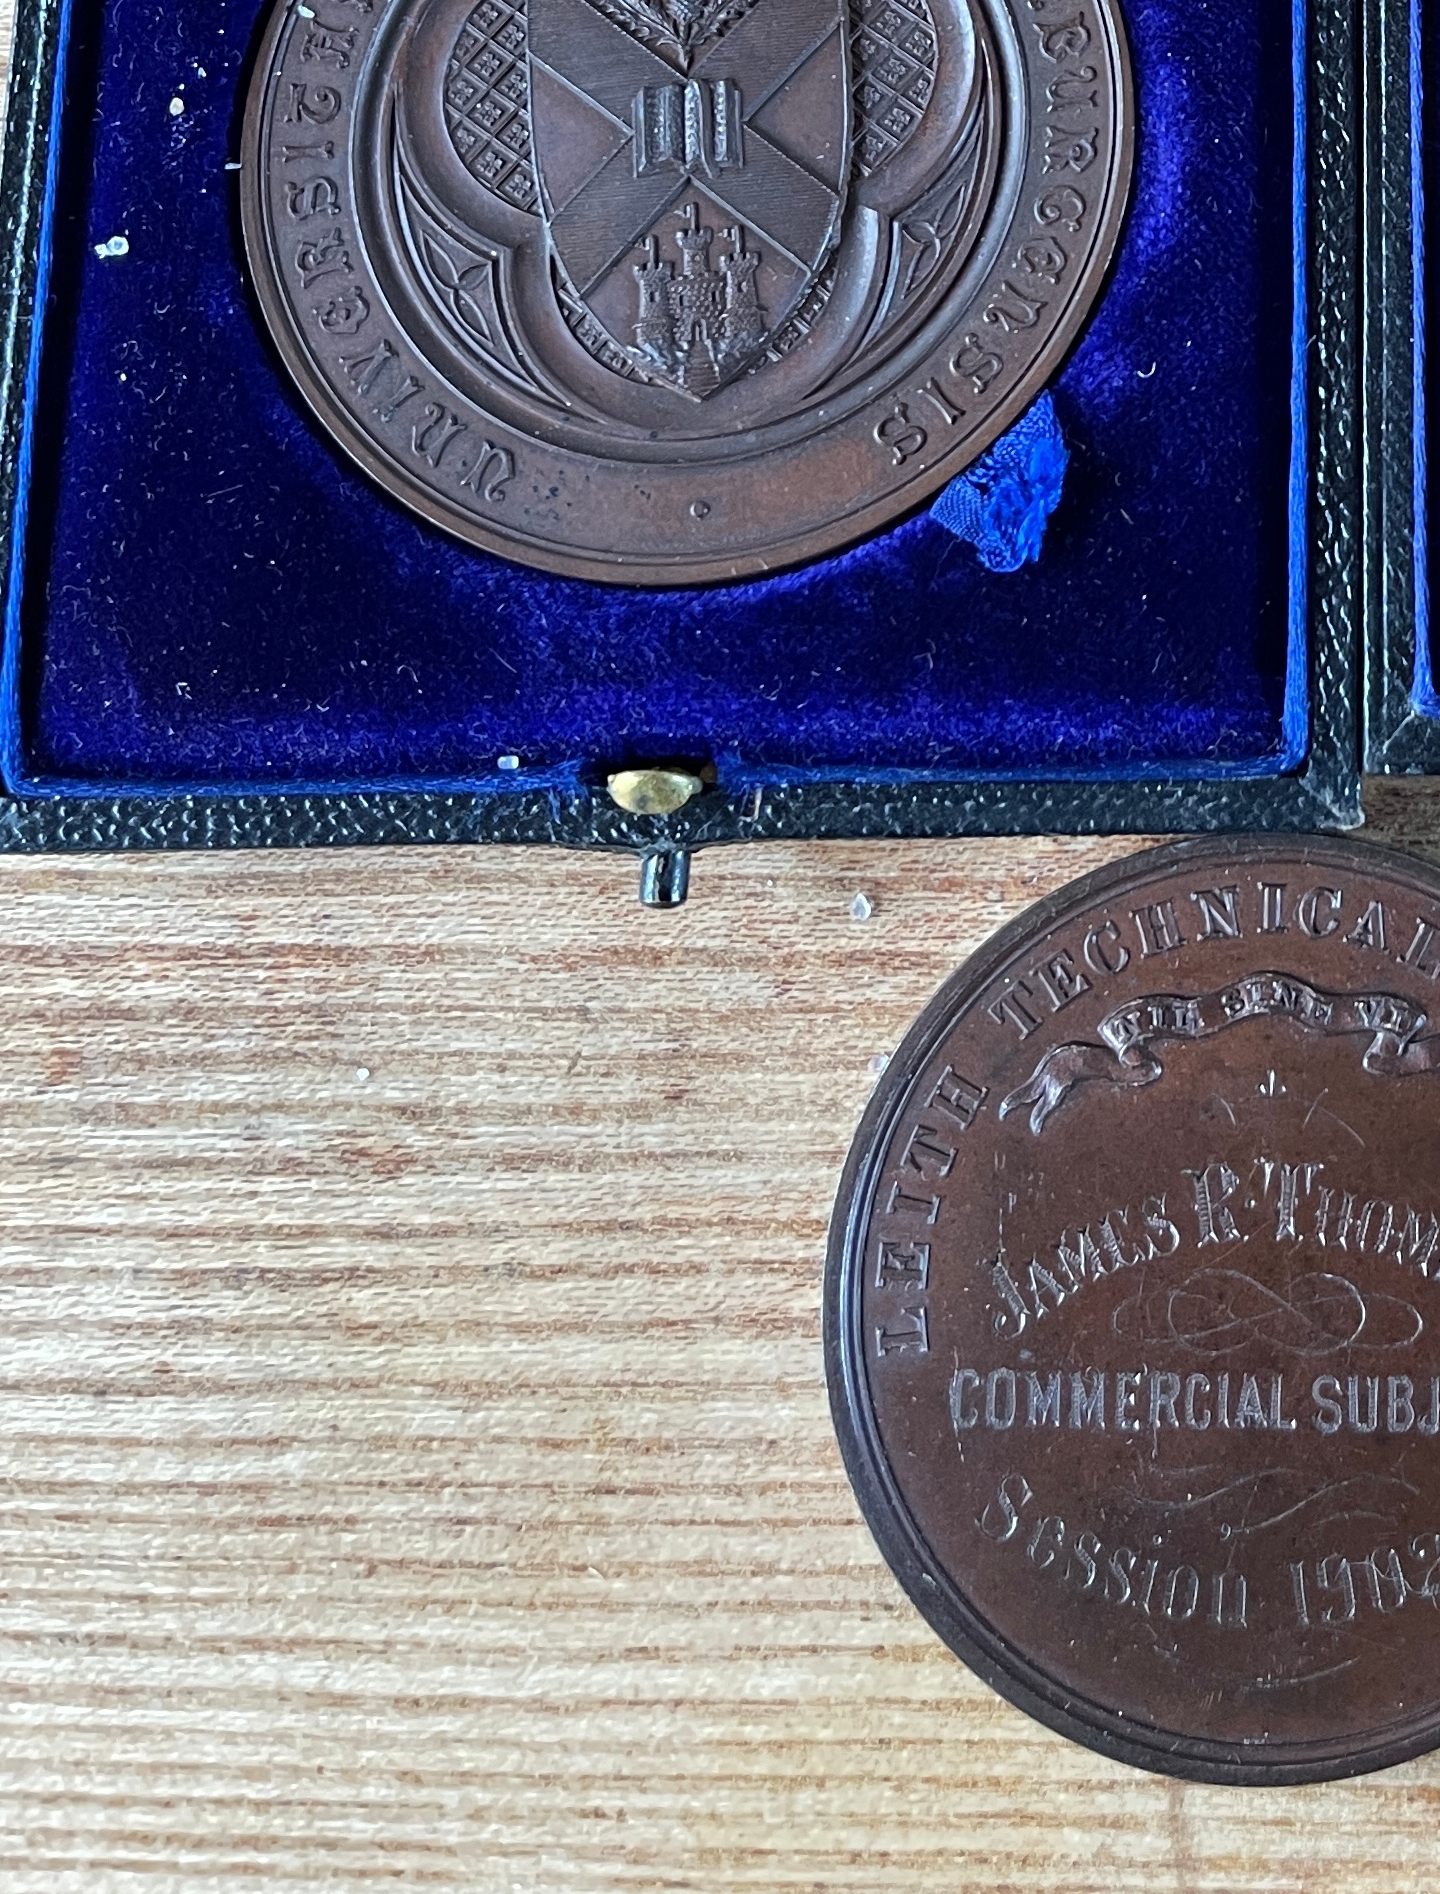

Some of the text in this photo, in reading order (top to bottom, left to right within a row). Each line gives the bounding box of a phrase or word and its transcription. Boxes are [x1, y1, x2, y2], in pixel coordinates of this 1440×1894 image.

[874, 1063, 990, 1357] LEITH
[985, 1191, 1181, 1340] JAMES
[949, 1367, 1298, 1433] COMMERCIAL
[975, 1472, 1250, 1630] Session
